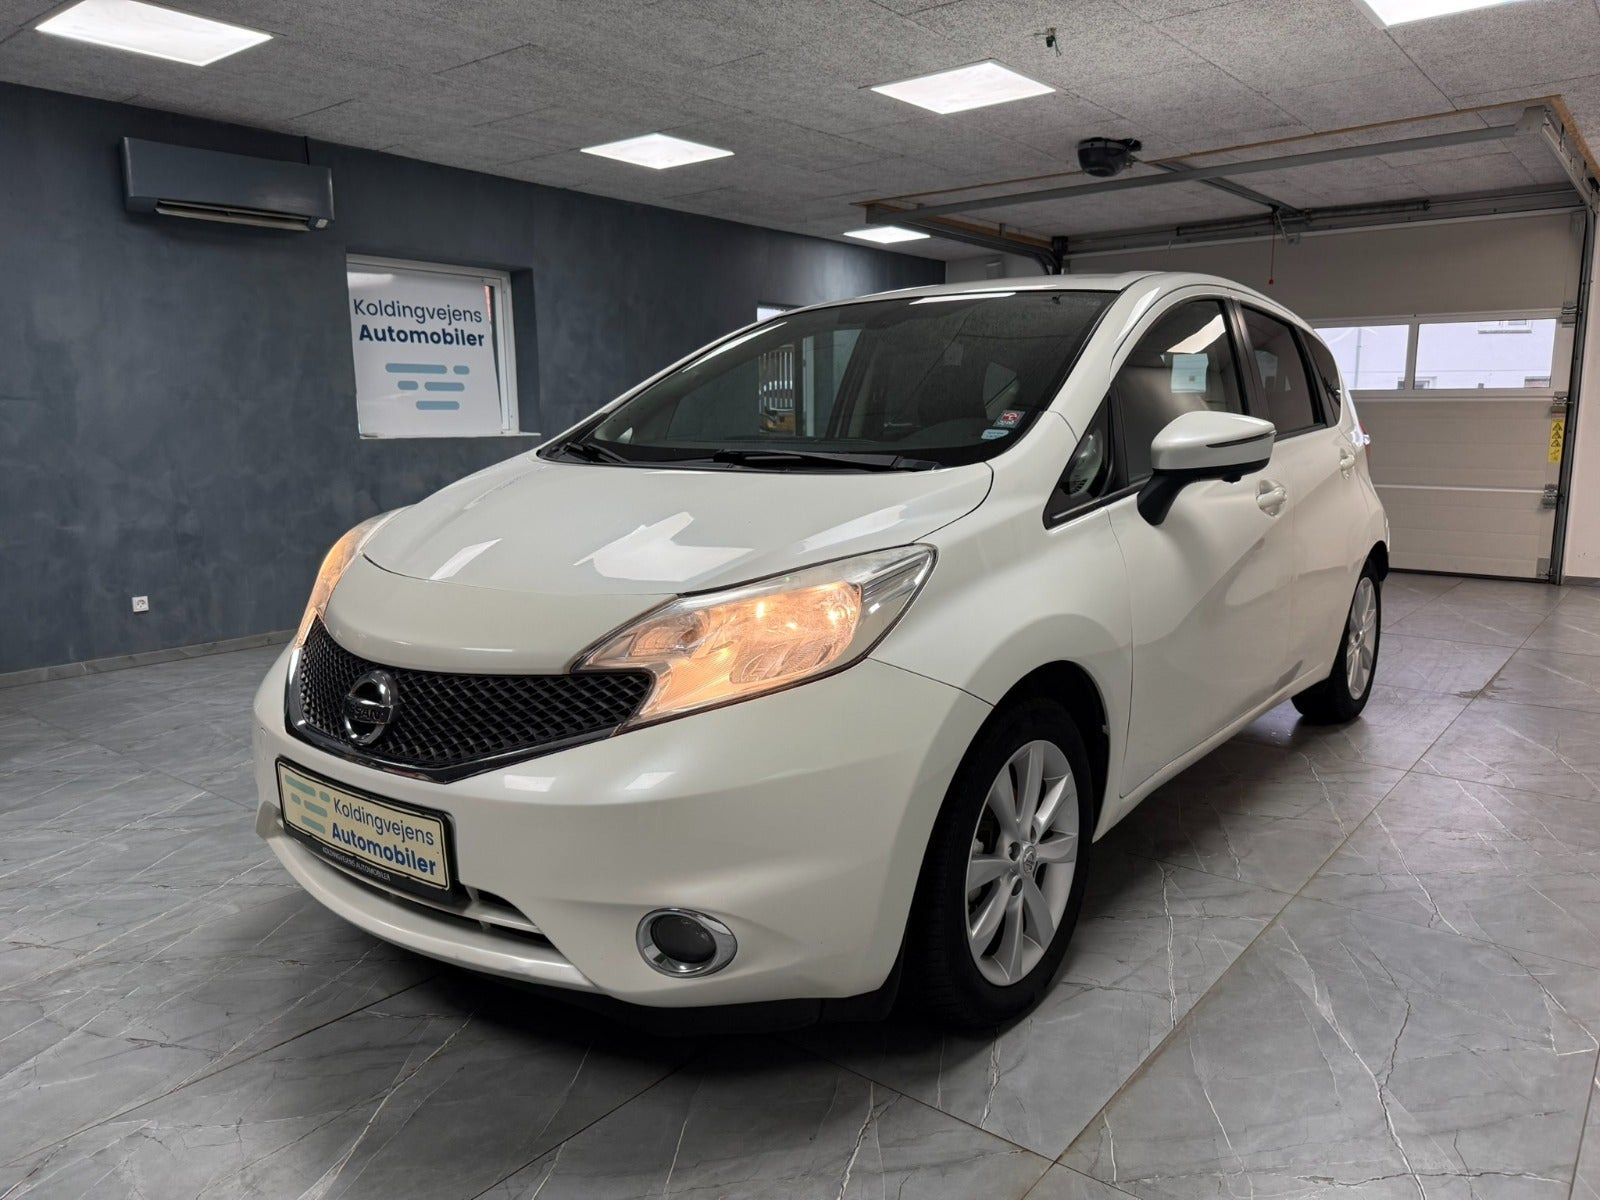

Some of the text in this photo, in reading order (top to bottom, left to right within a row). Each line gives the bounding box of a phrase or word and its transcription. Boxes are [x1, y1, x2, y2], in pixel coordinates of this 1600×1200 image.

[353, 299, 482, 325] Koldingvejens
[359, 324, 485, 346] Automobiler
[333, 797, 434, 846] Koldingvejens
[332, 822, 436, 876] Automobiler
